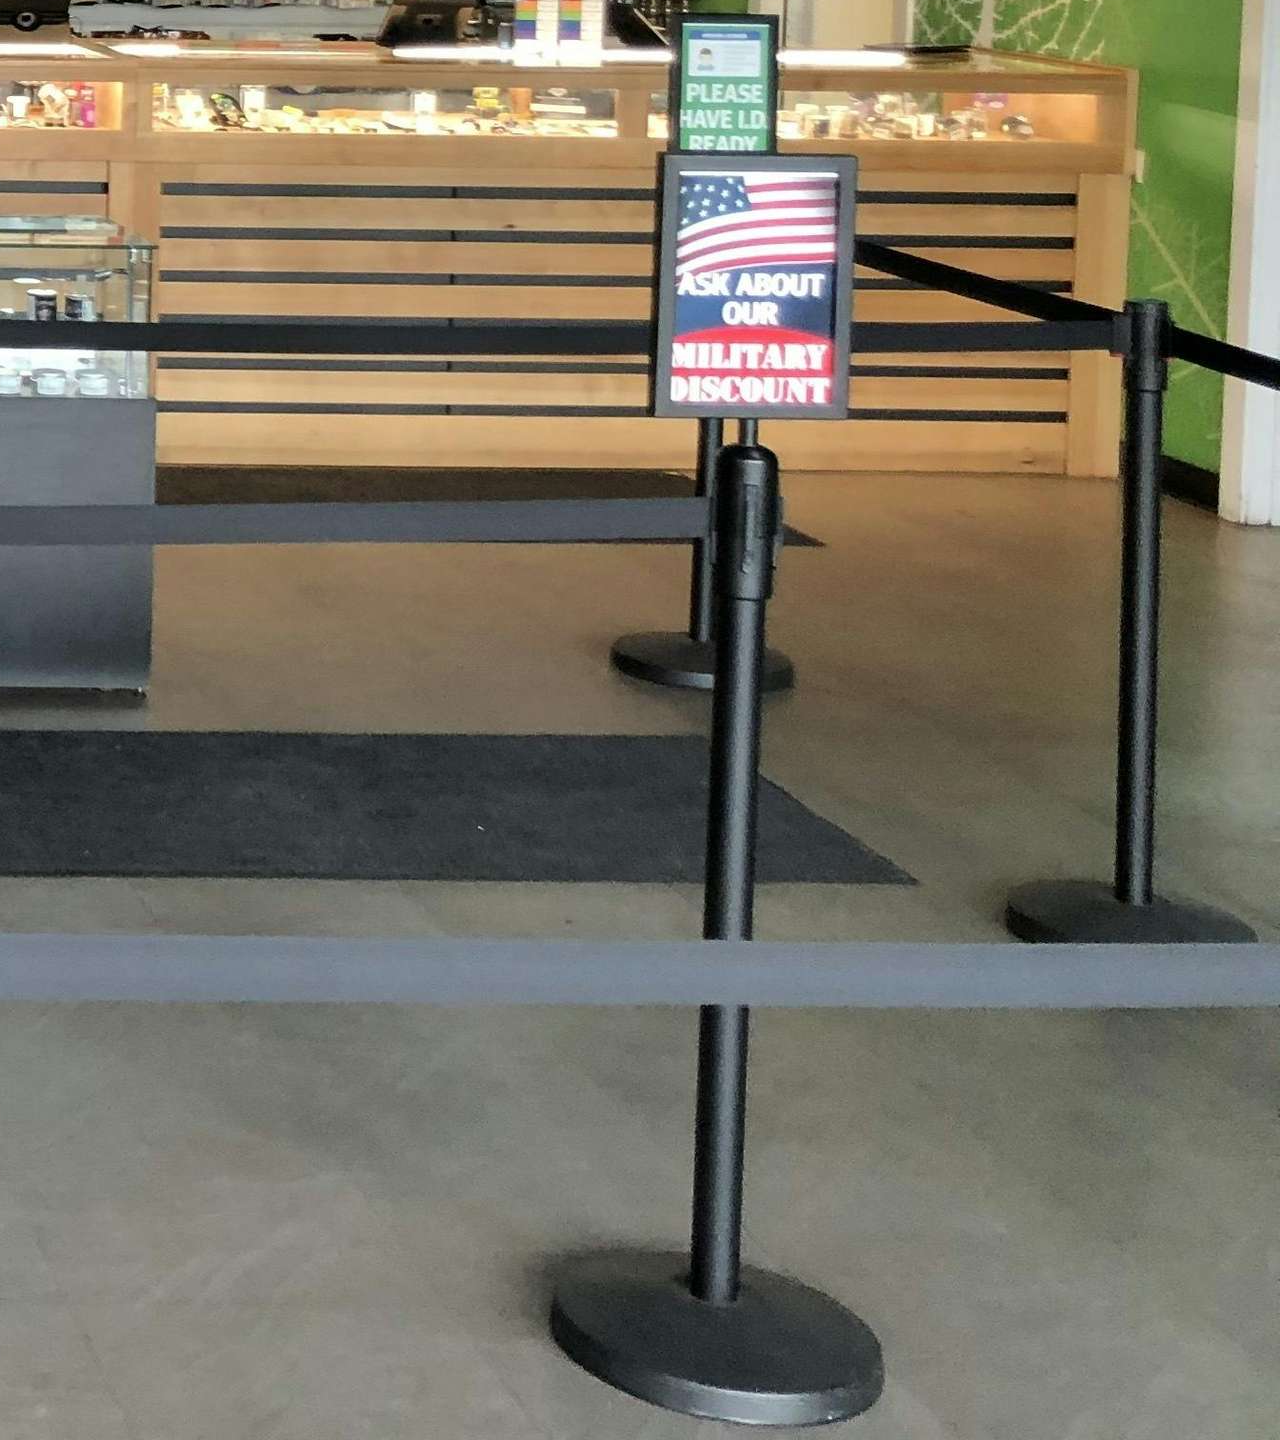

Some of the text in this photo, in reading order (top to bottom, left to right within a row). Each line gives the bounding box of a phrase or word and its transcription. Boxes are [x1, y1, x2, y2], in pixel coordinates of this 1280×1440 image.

[686, 83, 764, 104] PLEASE
[680, 109, 733, 129] HAVE
[688, 135, 759, 151] READY
[677, 272, 826, 298] ASK ABOUT
[721, 300, 779, 327] OUR
[671, 342, 828, 372] MILITARY
[670, 375, 831, 405] DISCOUNT
